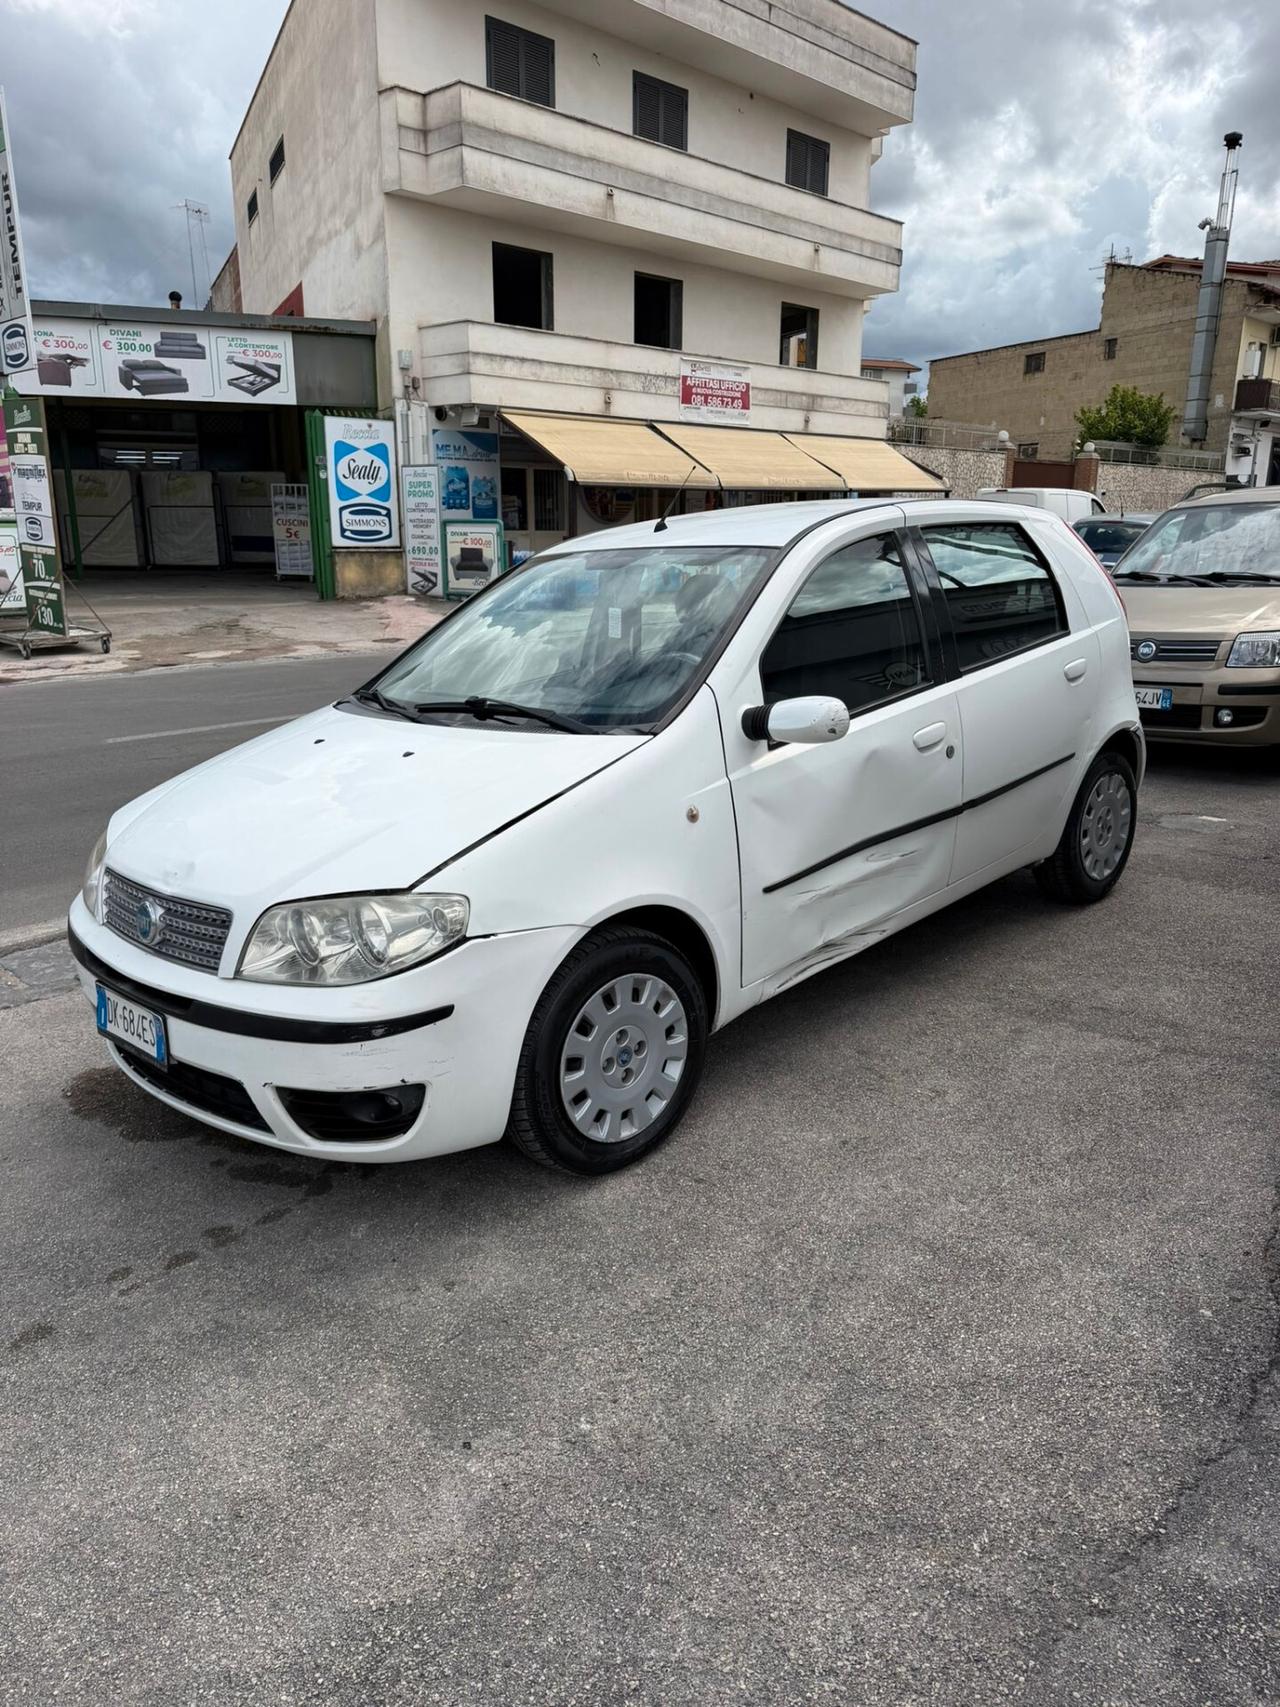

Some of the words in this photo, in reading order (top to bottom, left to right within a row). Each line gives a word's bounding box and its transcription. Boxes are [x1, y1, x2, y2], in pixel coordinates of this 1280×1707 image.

[109, 329, 142, 338] DIVANI
[54, 340, 88, 350] 300,00
[102, 340, 112, 350] €
[686, 377, 719, 389] AFFITTASI
[721, 381, 746, 391] UFFICIO
[342, 458, 381, 485] Sealy
[408, 481, 432, 489] SUPER
[408, 490, 434, 498] PROMO
[22, 501, 42, 511] TEMPUR
[276, 519, 308, 527] CUSCINI
[345, 518, 387, 527] SIMMONS
[33, 560, 46, 578] 70
[107, 997, 119, 1029] DK
[122, 1005, 156, 1047] 684ES
